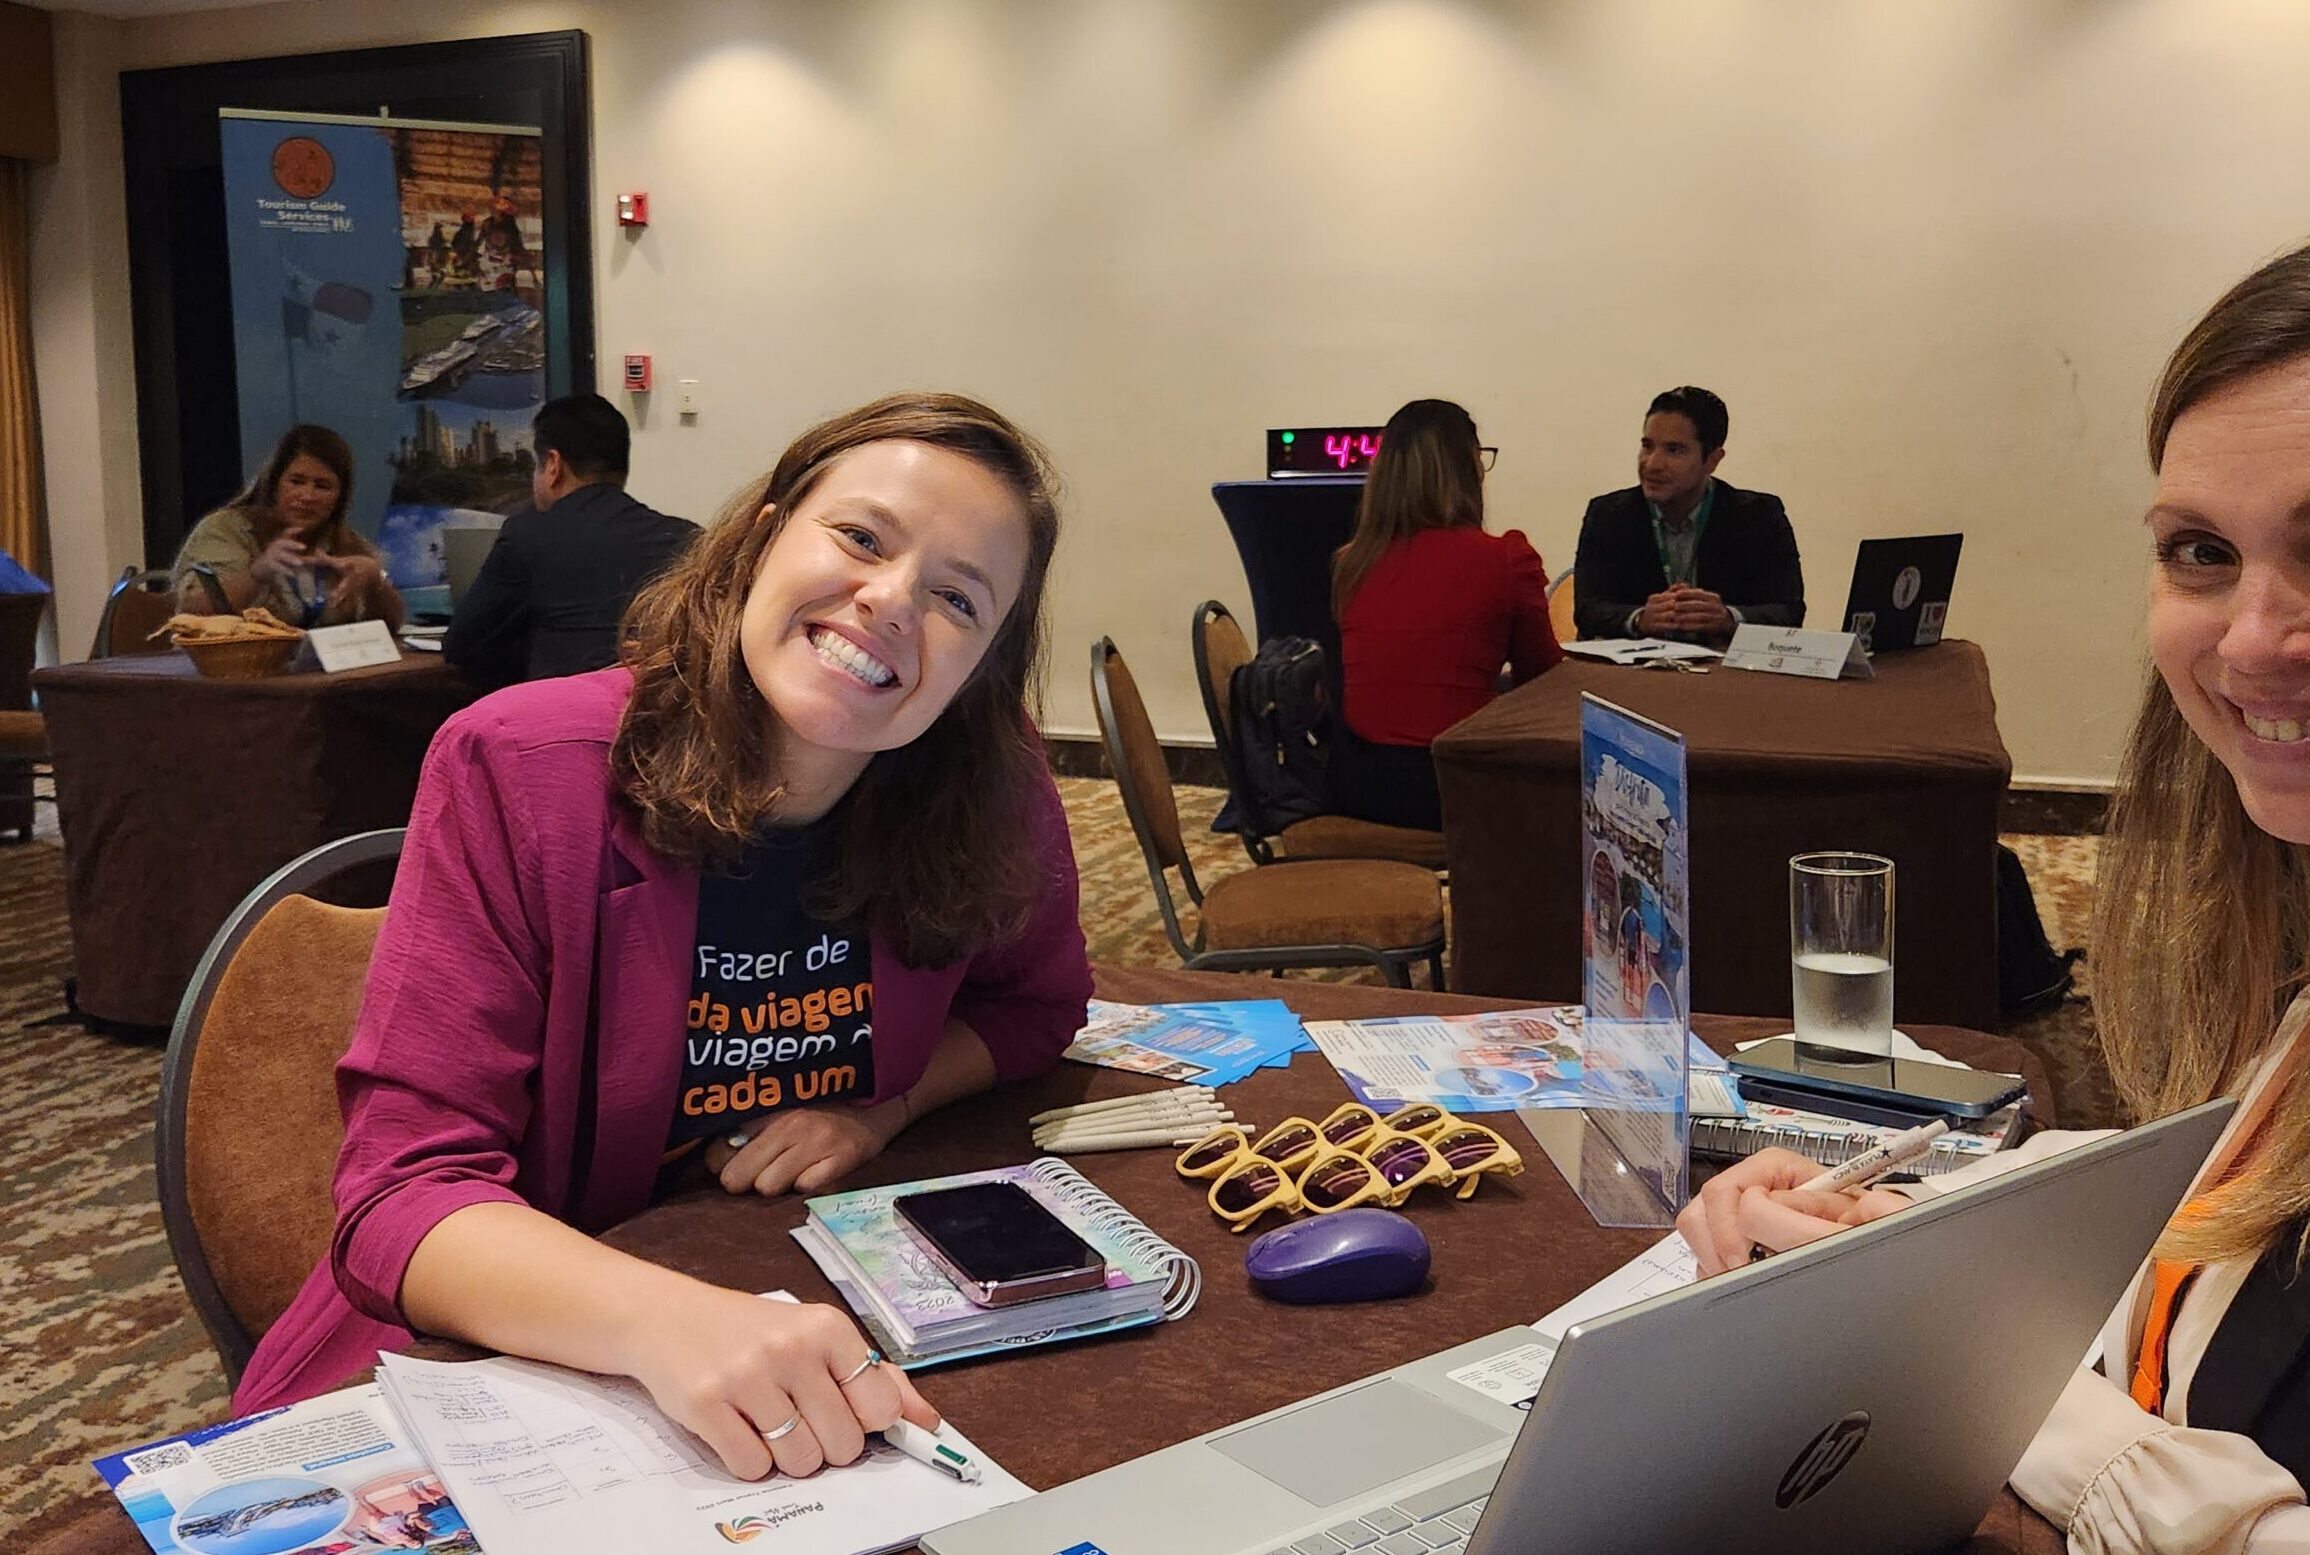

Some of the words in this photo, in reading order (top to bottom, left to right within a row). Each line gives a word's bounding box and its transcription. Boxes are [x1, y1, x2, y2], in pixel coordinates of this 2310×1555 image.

[256, 199, 307, 211] Tourism
[309, 201, 346, 212] Guide
[277, 211, 328, 221] Services
[697, 945, 793, 981] Fazer
[806, 934, 850, 972] de
[687, 1030, 836, 1071] viagem
[683, 1072, 782, 1116] cada
[794, 1064, 857, 1100] um
[1858, 1152, 1882, 1167] PLAYA
[1832, 1162, 1860, 1180] BLANCA
[766, 1501, 824, 1528] PANAMÁ
